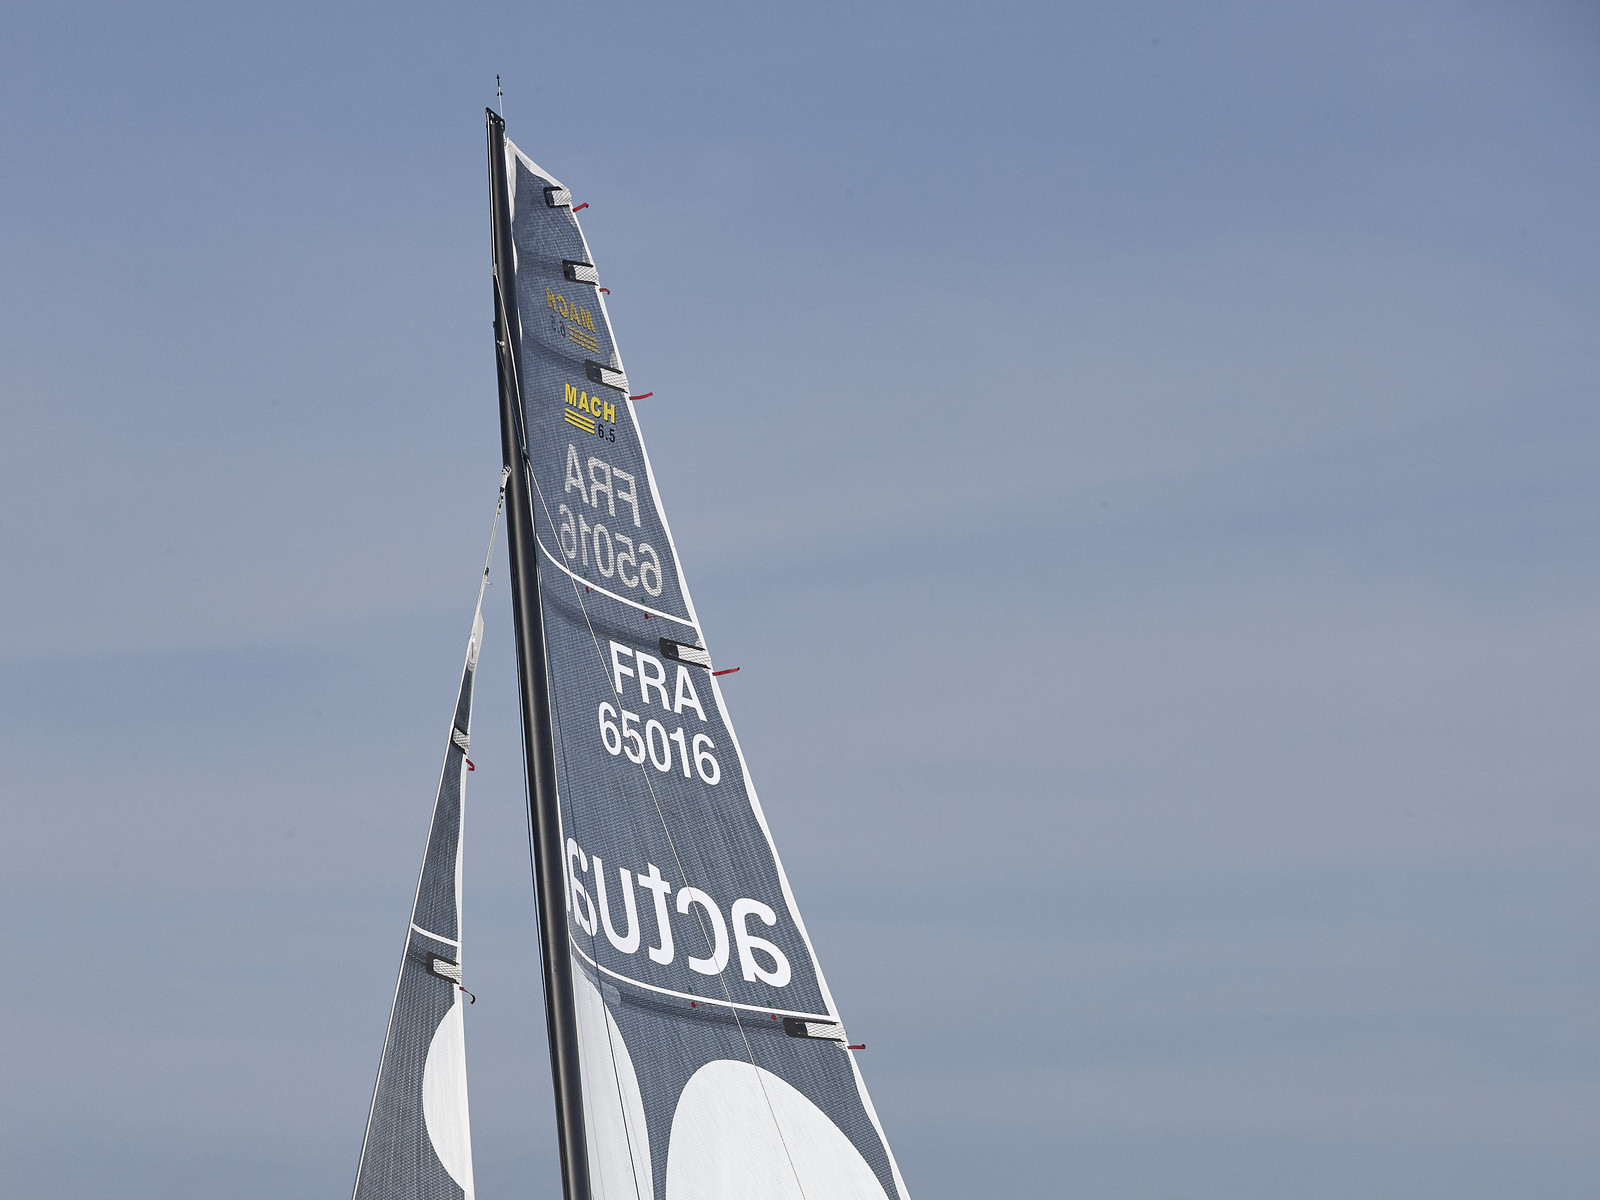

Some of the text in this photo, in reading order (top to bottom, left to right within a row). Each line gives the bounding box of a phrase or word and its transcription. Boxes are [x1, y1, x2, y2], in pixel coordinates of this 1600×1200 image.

[564, 383, 616, 424] MACH
[597, 423, 616, 443] 6.5
[609, 640, 707, 722] FRA
[598, 701, 722, 786] 65016
